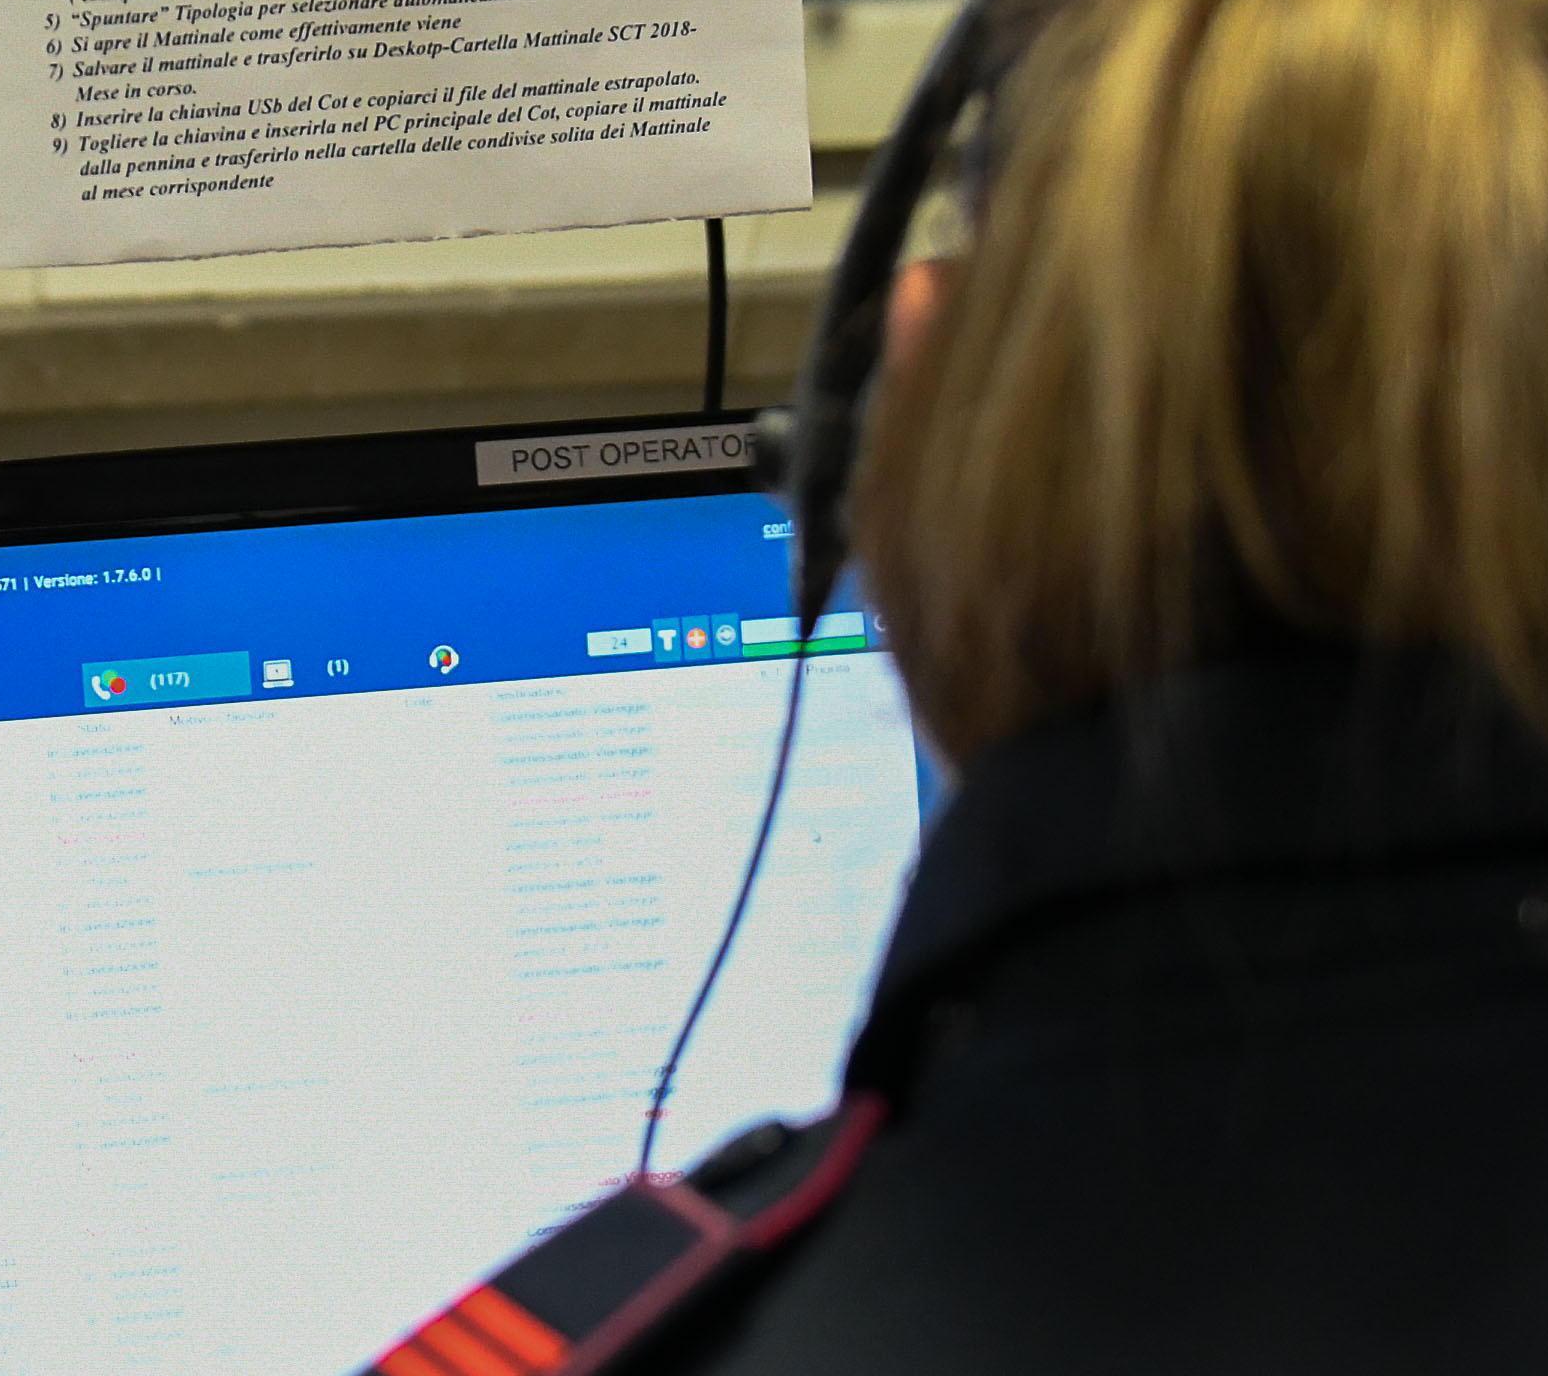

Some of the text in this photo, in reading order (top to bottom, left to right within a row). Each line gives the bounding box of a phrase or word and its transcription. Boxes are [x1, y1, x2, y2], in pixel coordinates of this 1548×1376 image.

[46, 14, 461, 57] 6) Si apre il Mattinale come effettivamente viene
[512, 444, 589, 473] POST
[33, 574, 98, 588] Versione:
[103, 568, 151, 583] 1.7.6.0
[326, 657, 350, 676] (1)
[149, 670, 191, 690] (117)
